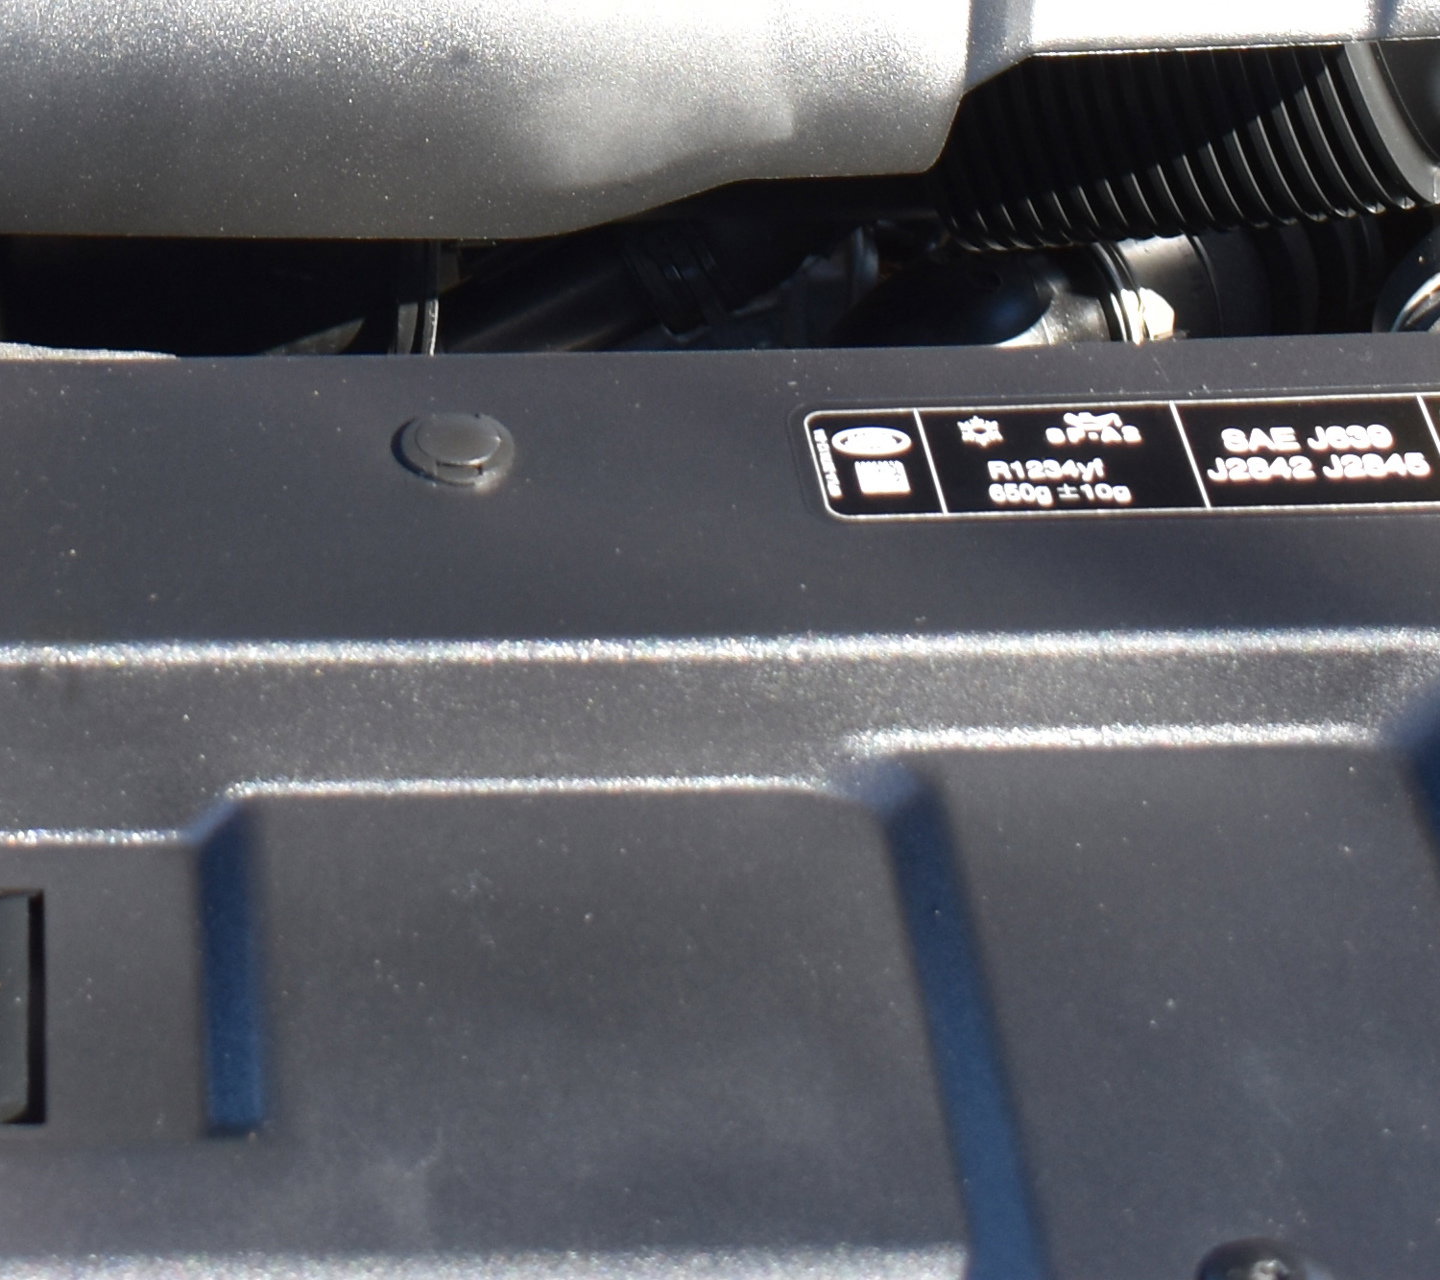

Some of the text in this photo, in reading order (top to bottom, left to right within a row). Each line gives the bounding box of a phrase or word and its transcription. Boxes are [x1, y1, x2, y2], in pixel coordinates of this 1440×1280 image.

[1221, 427, 1301, 452] SAE
[987, 458, 1106, 482] R1234yf
[1207, 452, 1432, 481] J2842 J2845
